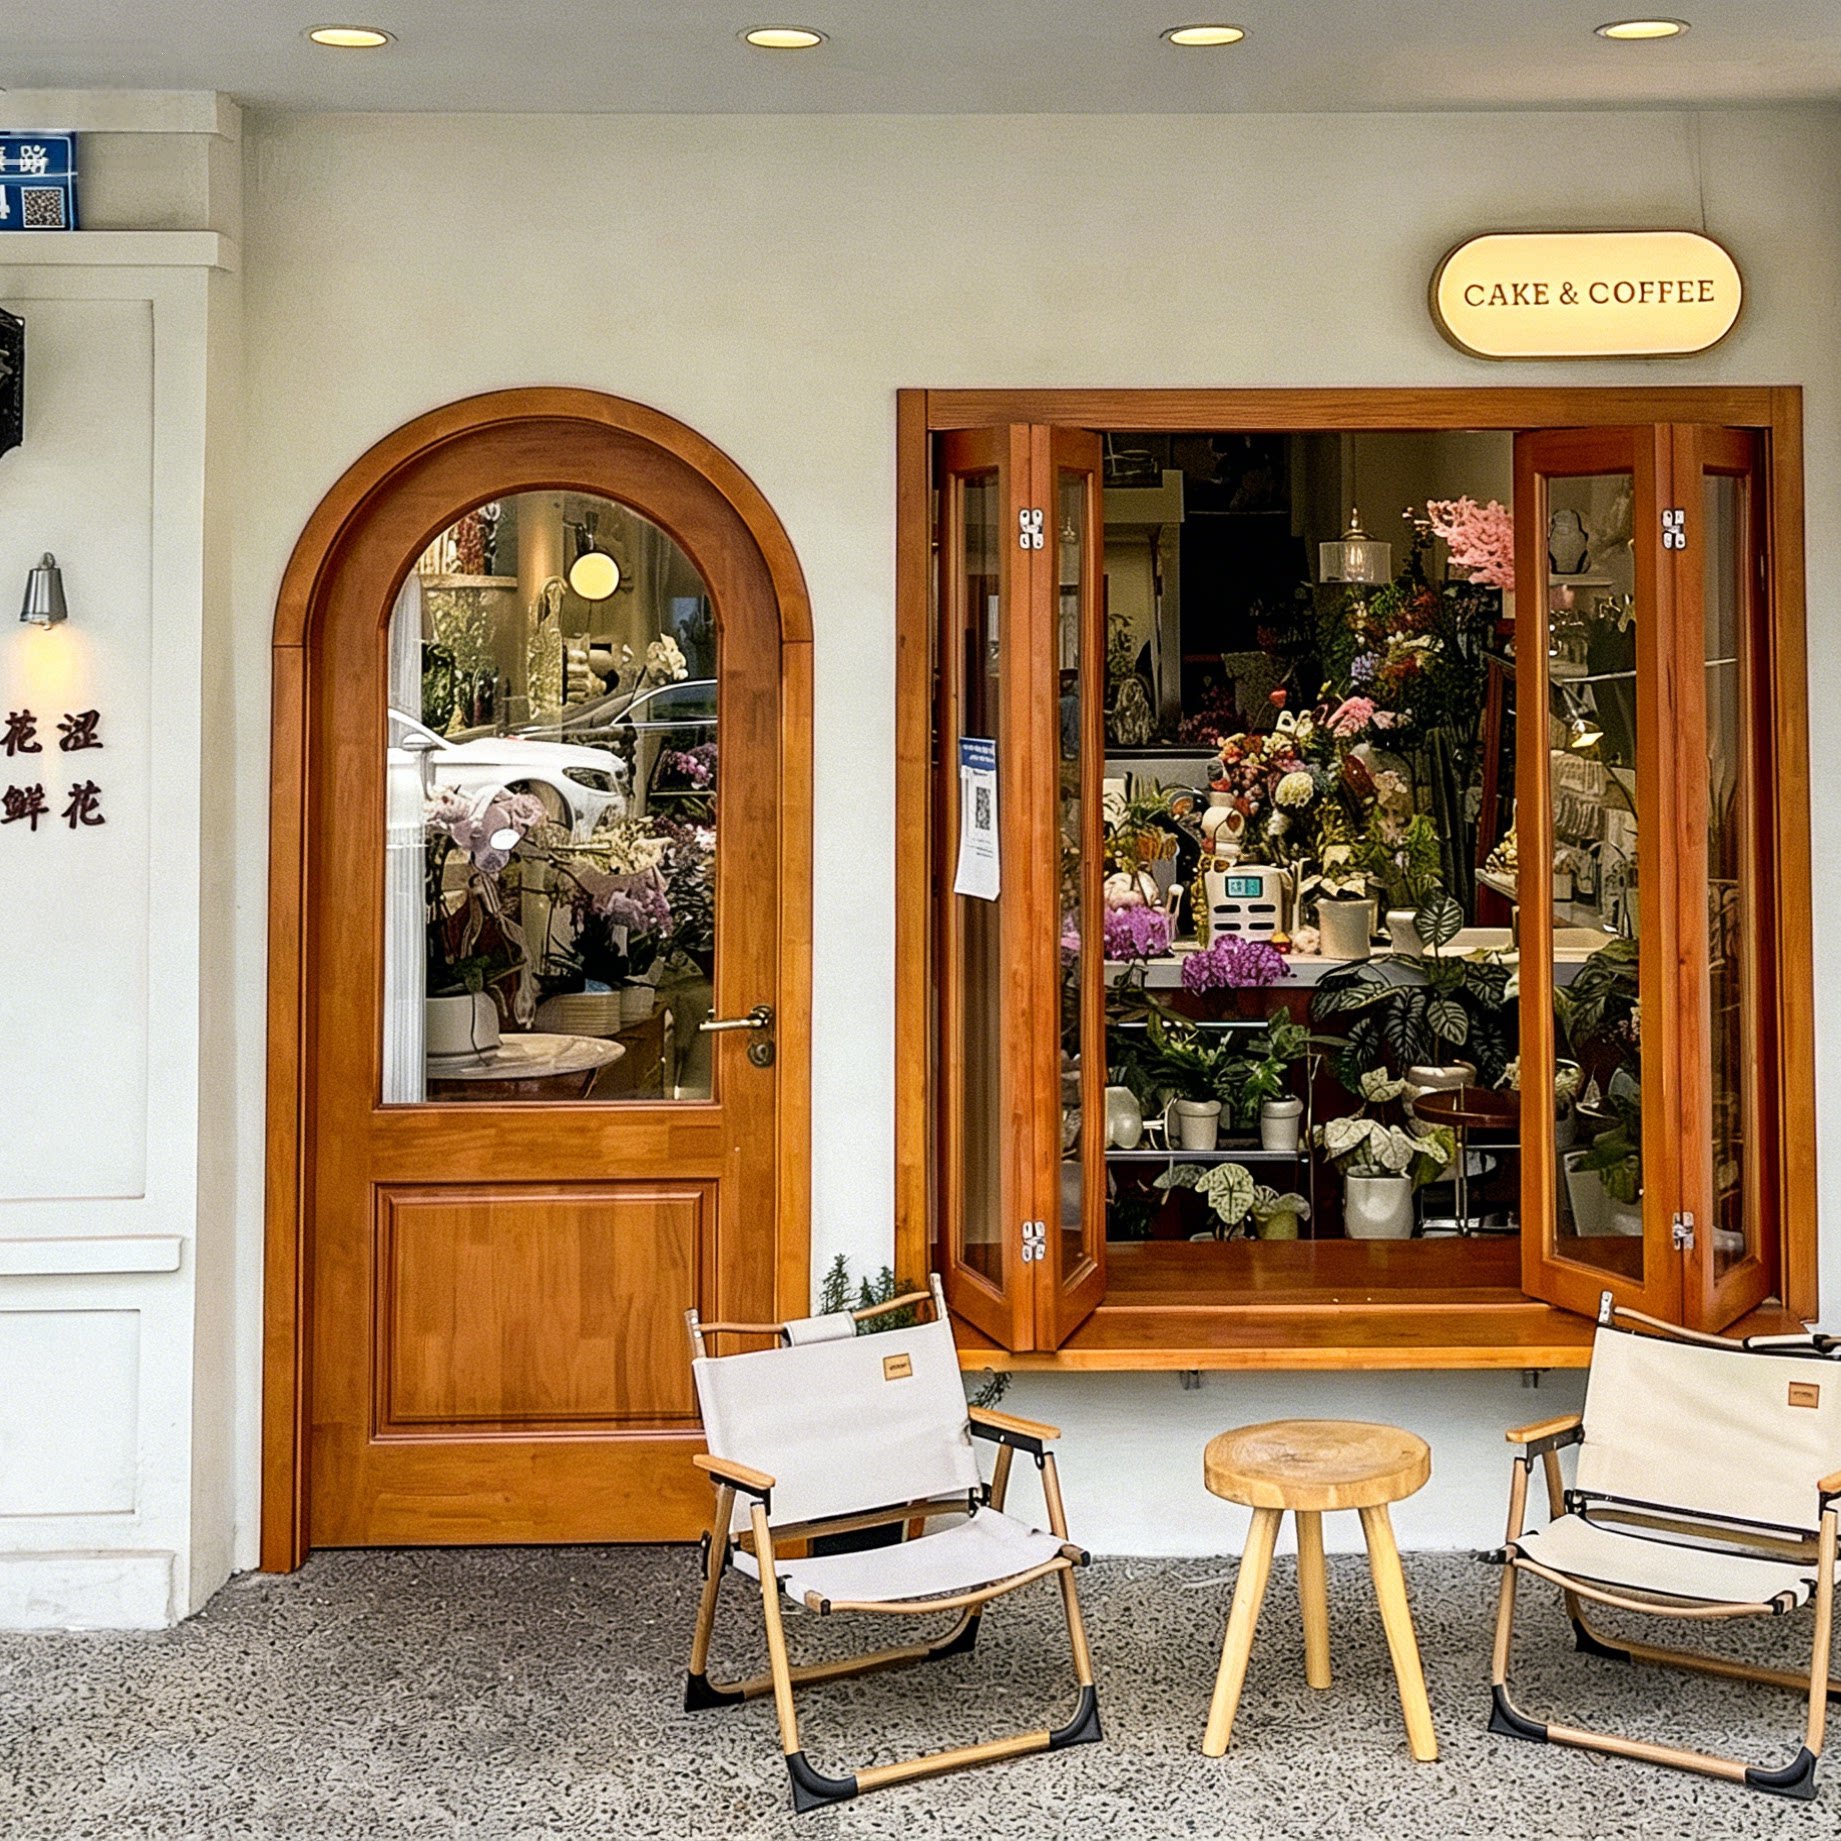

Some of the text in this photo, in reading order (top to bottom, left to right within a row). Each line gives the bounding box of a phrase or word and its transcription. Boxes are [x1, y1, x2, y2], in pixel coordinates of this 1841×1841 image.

[0, 145, 49, 175] 路
[1464, 280, 1715, 306] CAKE & COFFEE
[0, 779, 106, 832] 鲜花
